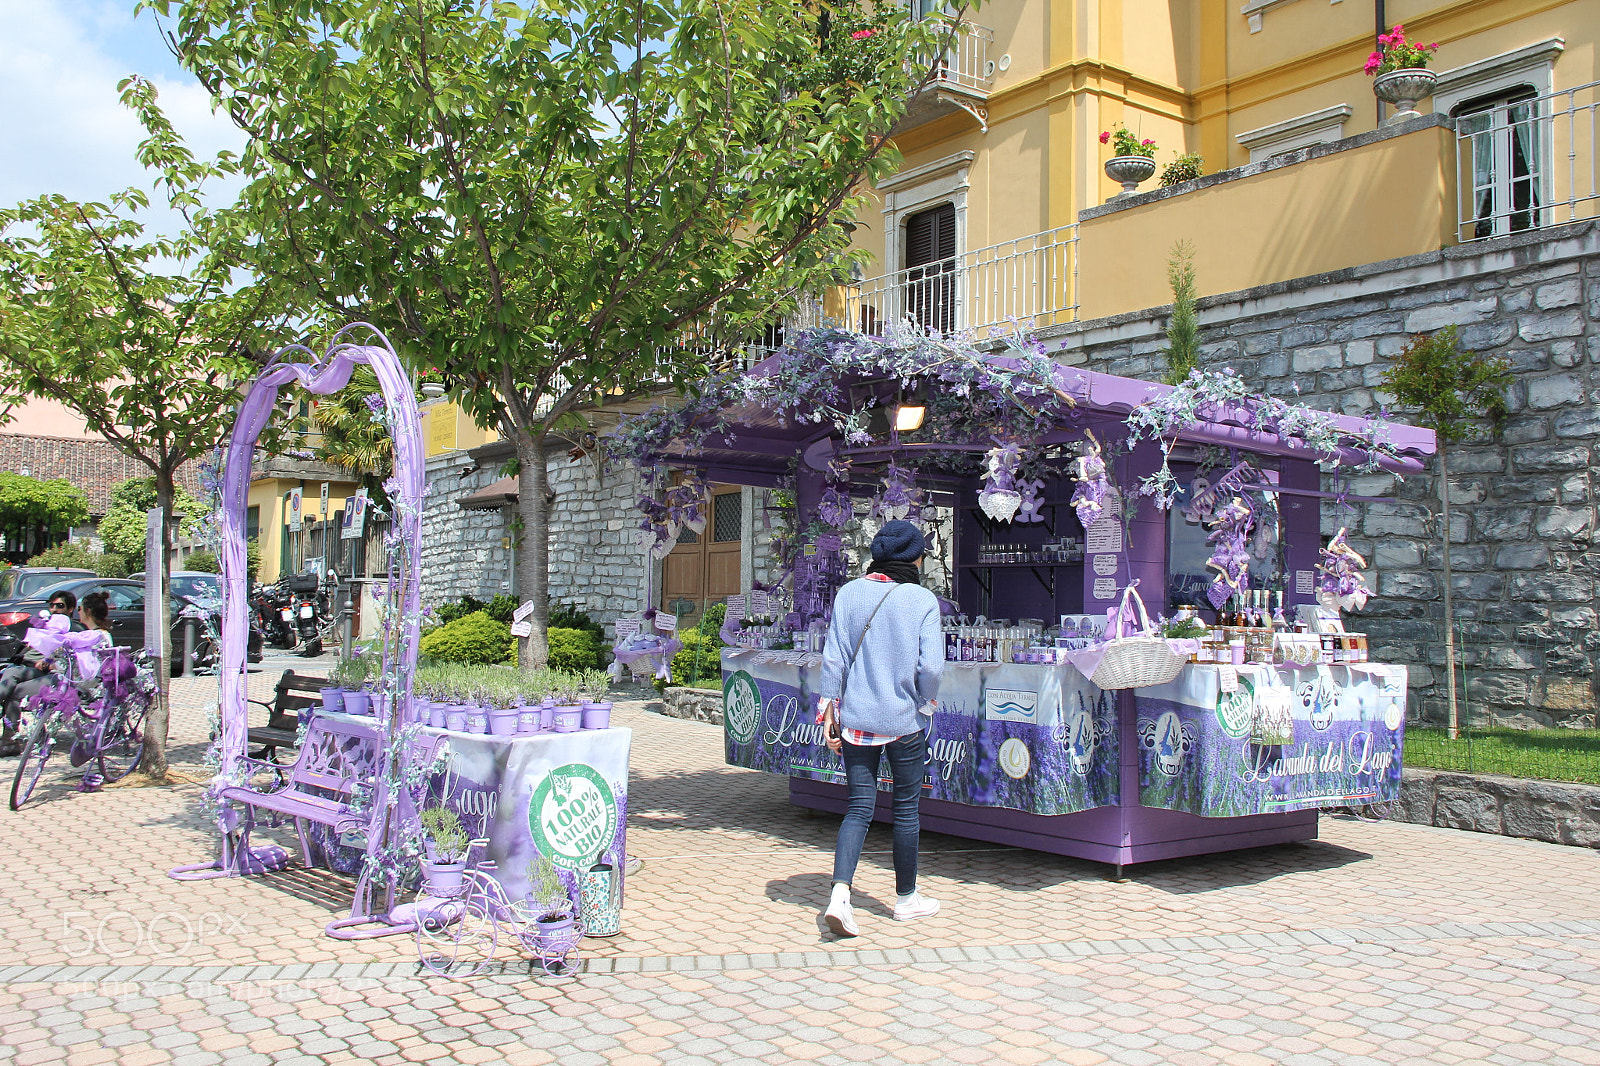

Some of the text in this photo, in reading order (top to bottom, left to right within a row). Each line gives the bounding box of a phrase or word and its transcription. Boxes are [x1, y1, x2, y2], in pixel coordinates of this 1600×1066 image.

[741, 715, 752, 735] BIO
[1234, 712, 1249, 729] BIO
[1319, 741, 1344, 773] del
[1349, 730, 1392, 783] Lago
[546, 786, 599, 836] 100%
[555, 802, 604, 849] NATURALE
[574, 824, 602, 855] BIO
